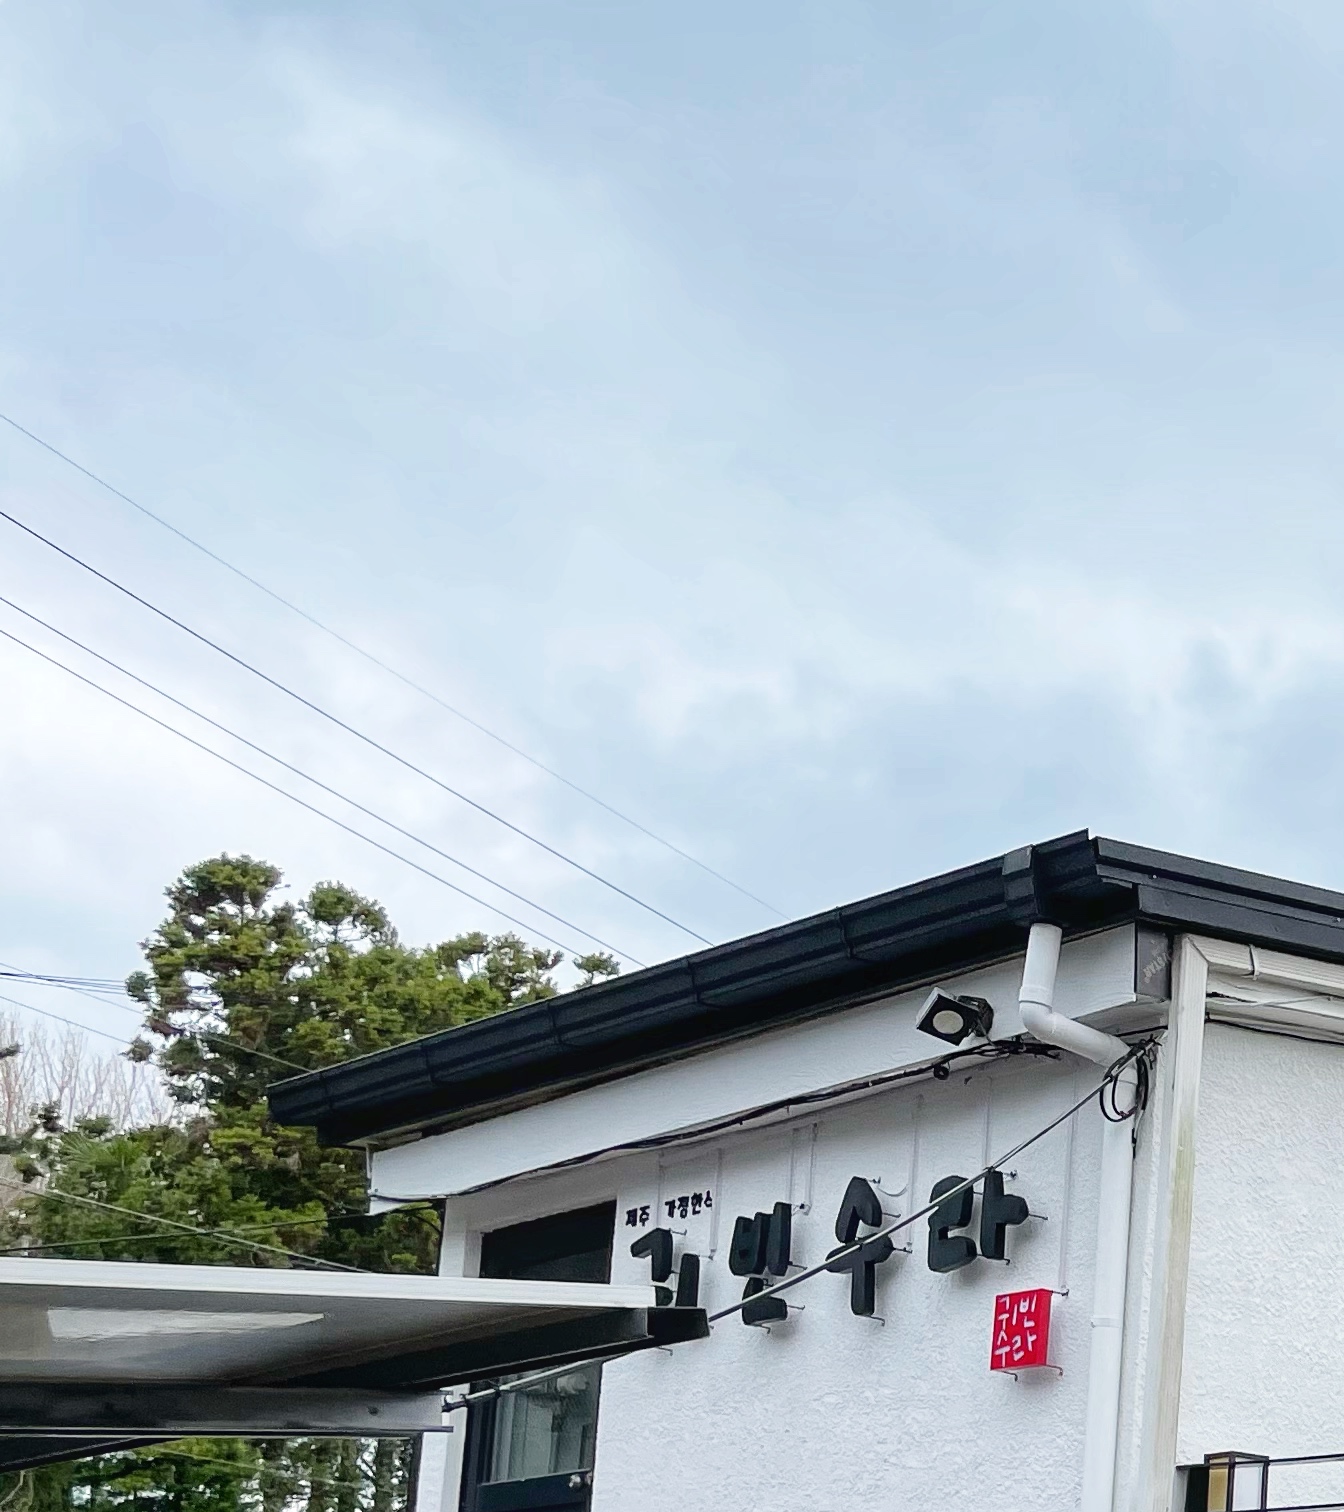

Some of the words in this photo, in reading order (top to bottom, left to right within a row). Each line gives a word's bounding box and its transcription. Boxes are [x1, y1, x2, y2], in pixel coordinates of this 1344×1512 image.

[625, 1205, 651, 1227] 제주
[998, 1293, 1038, 1330] 귀빈
[994, 1329, 1038, 1368] 수라
